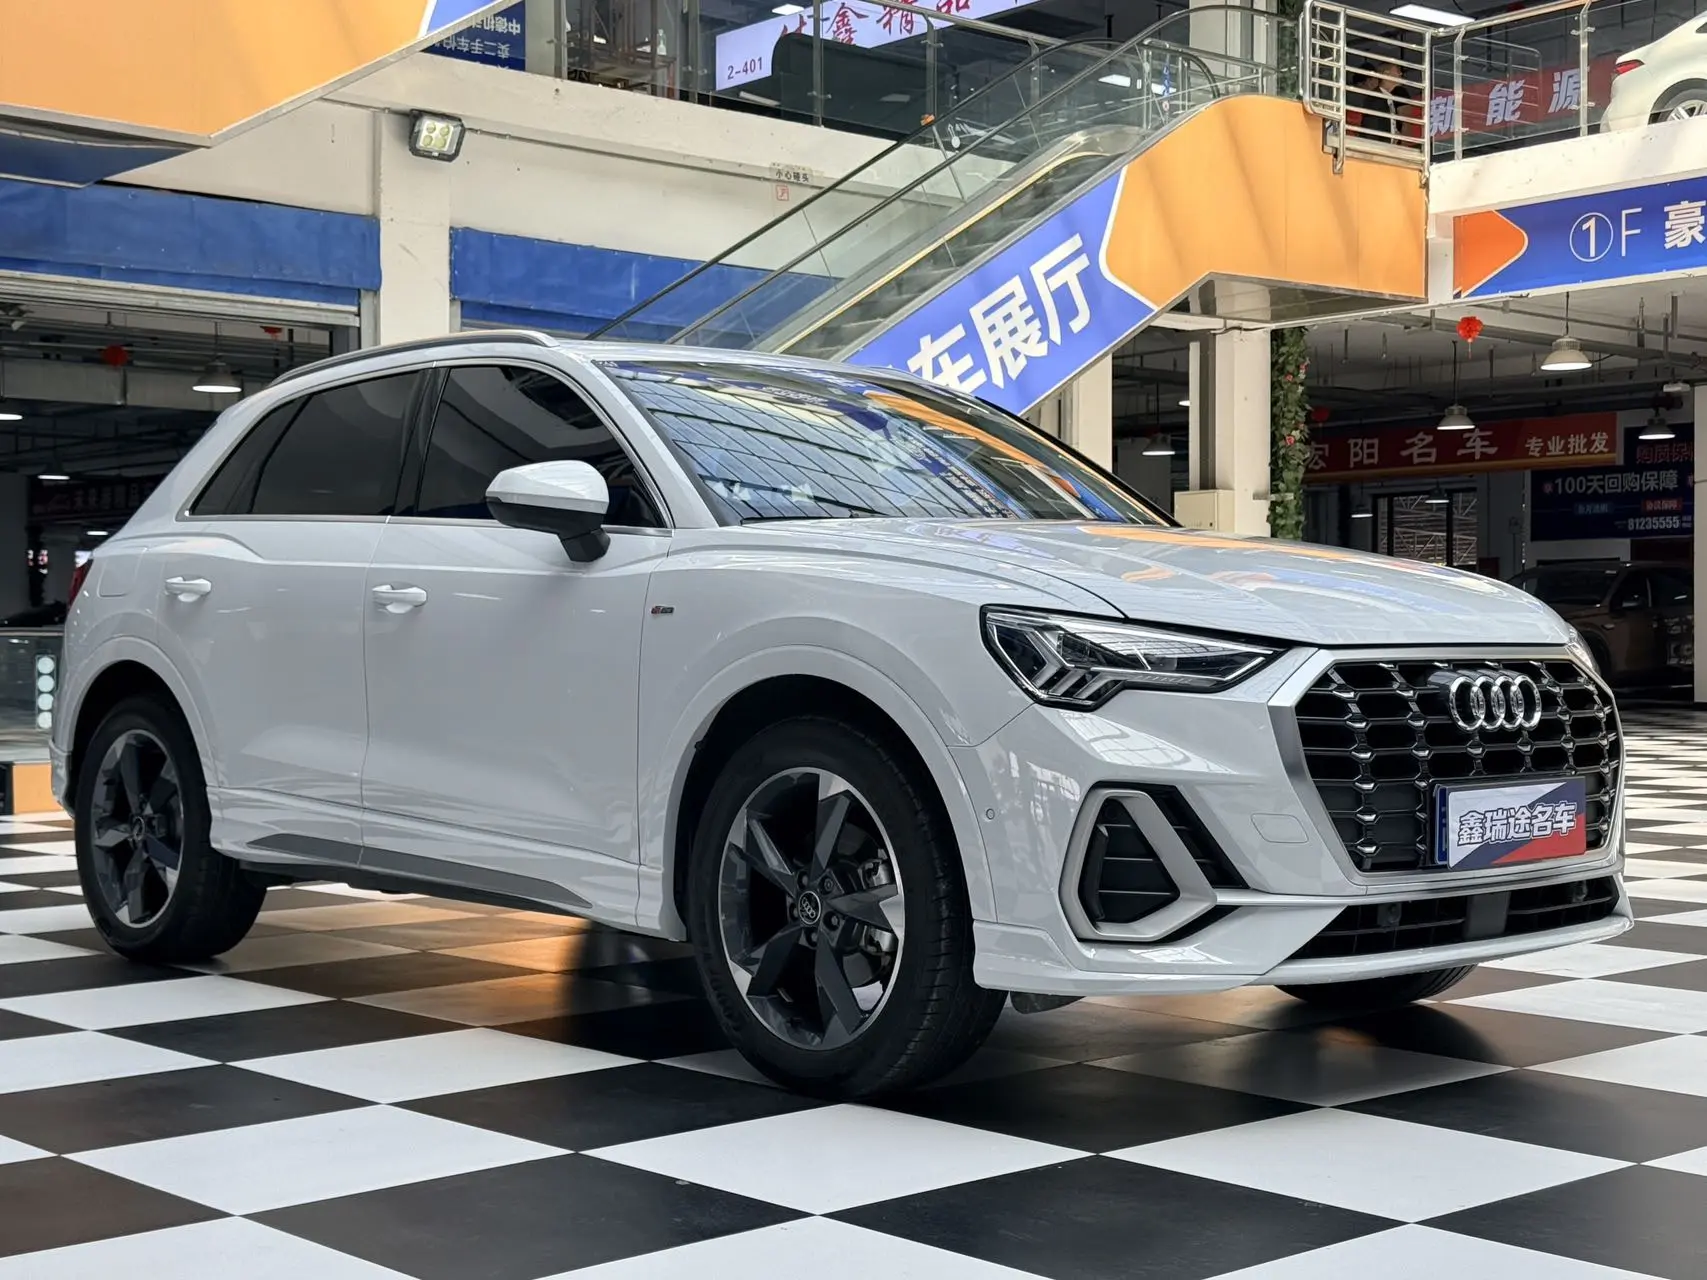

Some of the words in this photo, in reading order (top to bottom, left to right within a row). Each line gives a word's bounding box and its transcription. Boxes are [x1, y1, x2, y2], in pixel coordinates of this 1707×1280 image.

[472, 15, 520, 35] 中德机
[435, 36, 510, 59] 卖二手车怕
[727, 57, 763, 80] 2-401
[1430, 68, 1582, 137] 新能源
[886, 233, 1091, 394] 车展厅
[1305, 428, 1498, 470] 宏阳名车
[1525, 431, 1609, 457] 专业批发
[1554, 470, 1678, 495] 100天回购保障
[1627, 515, 1680, 531] 81235555
[1457, 801, 1577, 847] 鑫瑞途名车
